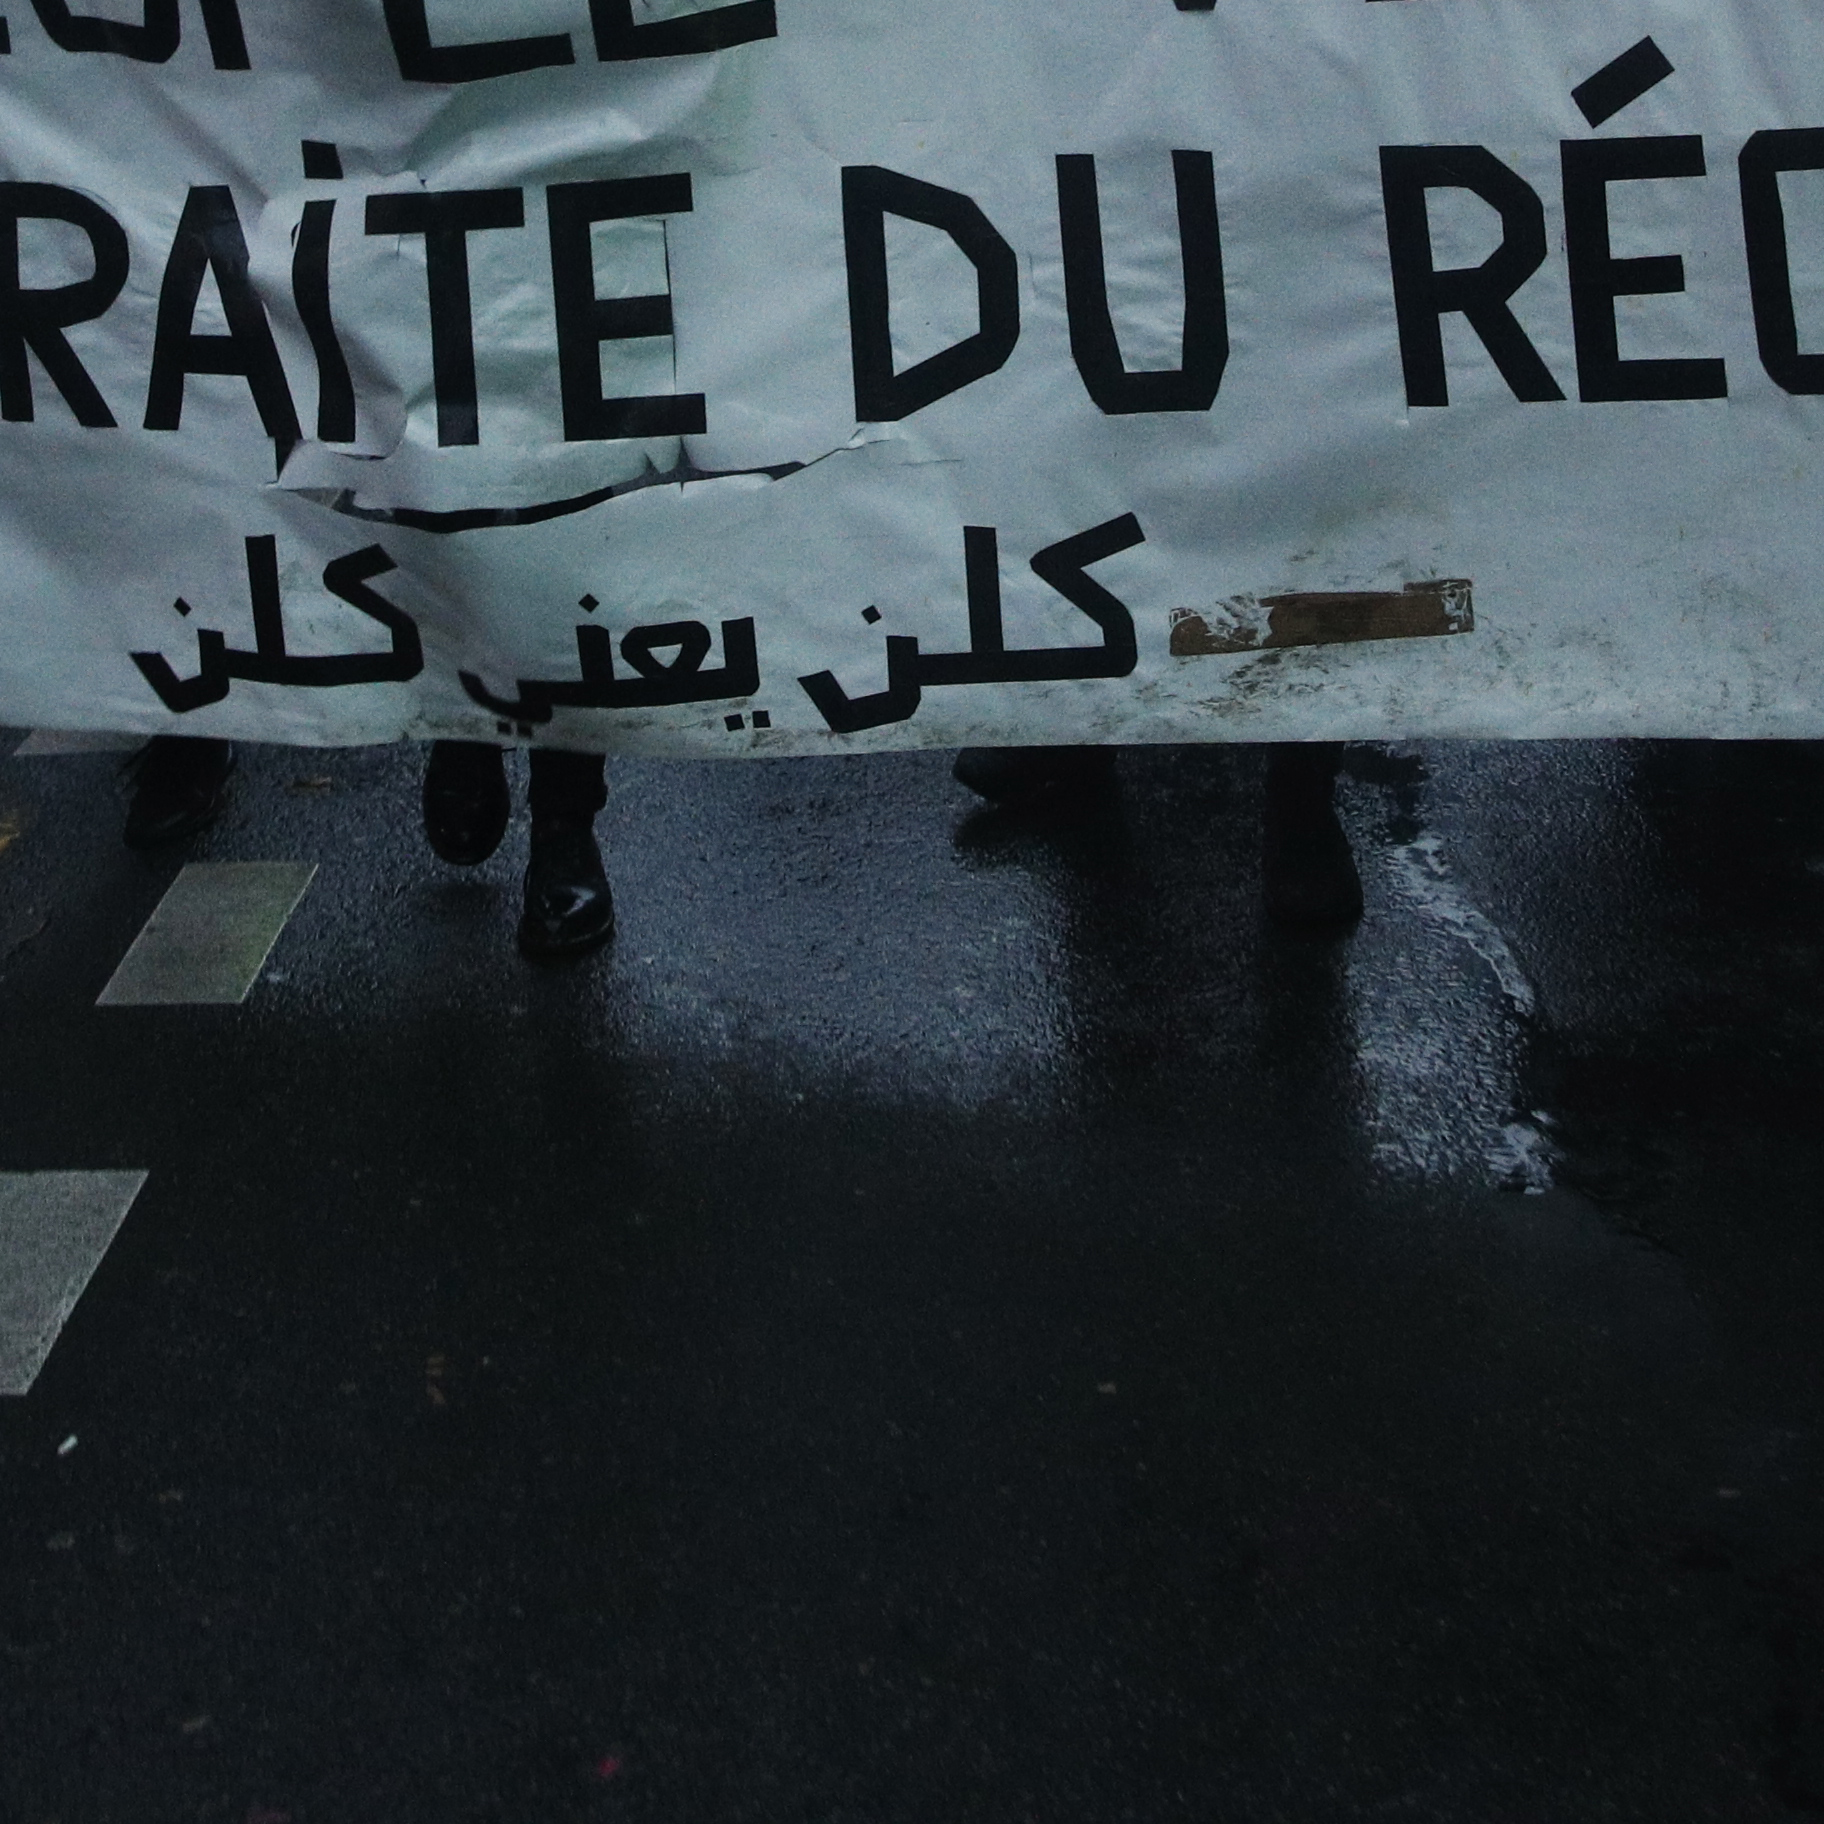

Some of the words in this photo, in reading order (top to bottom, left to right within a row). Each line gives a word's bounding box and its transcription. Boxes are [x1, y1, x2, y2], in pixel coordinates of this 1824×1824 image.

[841, 149, 1230, 423] DU
[129, 533, 425, 714] كلن
[797, 511, 1146, 734] كلن
